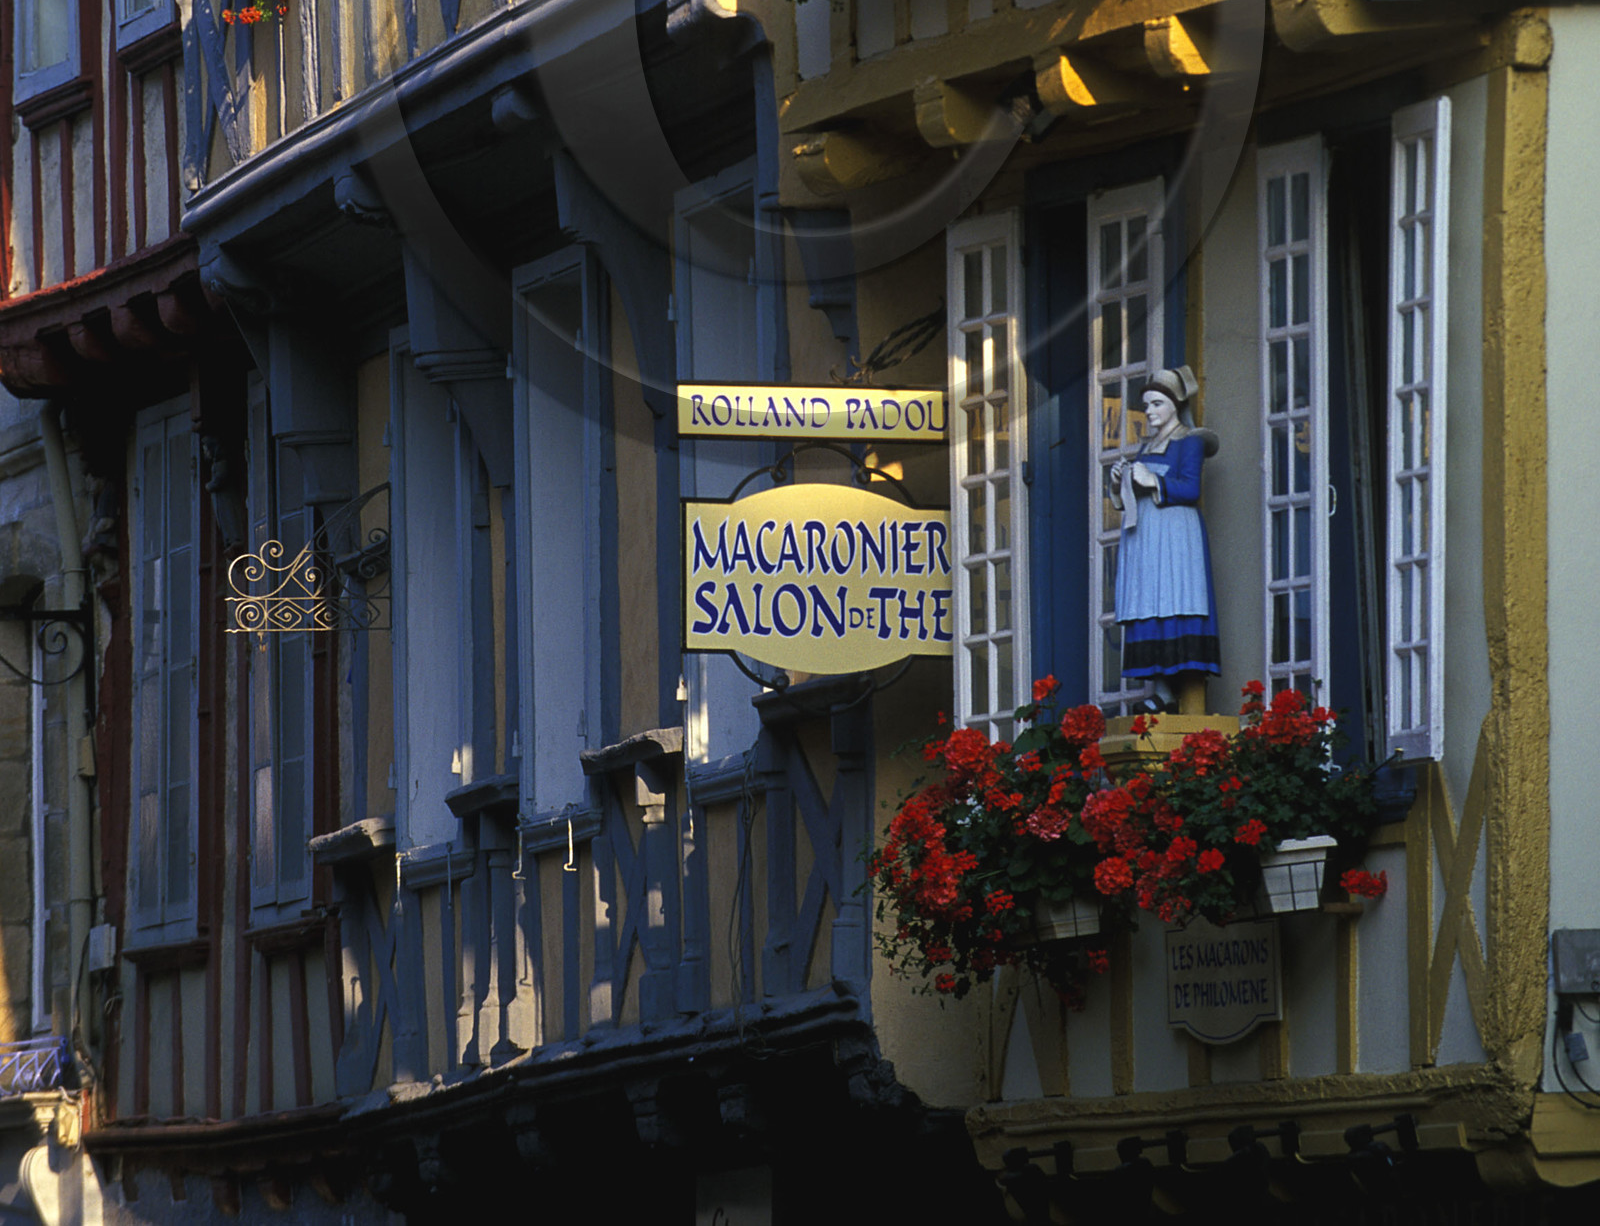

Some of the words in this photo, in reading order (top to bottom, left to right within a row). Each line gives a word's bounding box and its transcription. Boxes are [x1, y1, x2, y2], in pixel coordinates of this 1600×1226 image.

[690, 394, 831, 428] ROLLAND
[692, 519, 952, 575] MACARONIER
[692, 581, 848, 638] SALON
[849, 607, 875, 630] DE
[868, 587, 953, 641] THE
[1172, 945, 1193, 970] LES
[1197, 939, 1268, 967] MACARONS
[1174, 983, 1191, 1008] DE
[1193, 979, 1268, 1007] PHILOMENE
